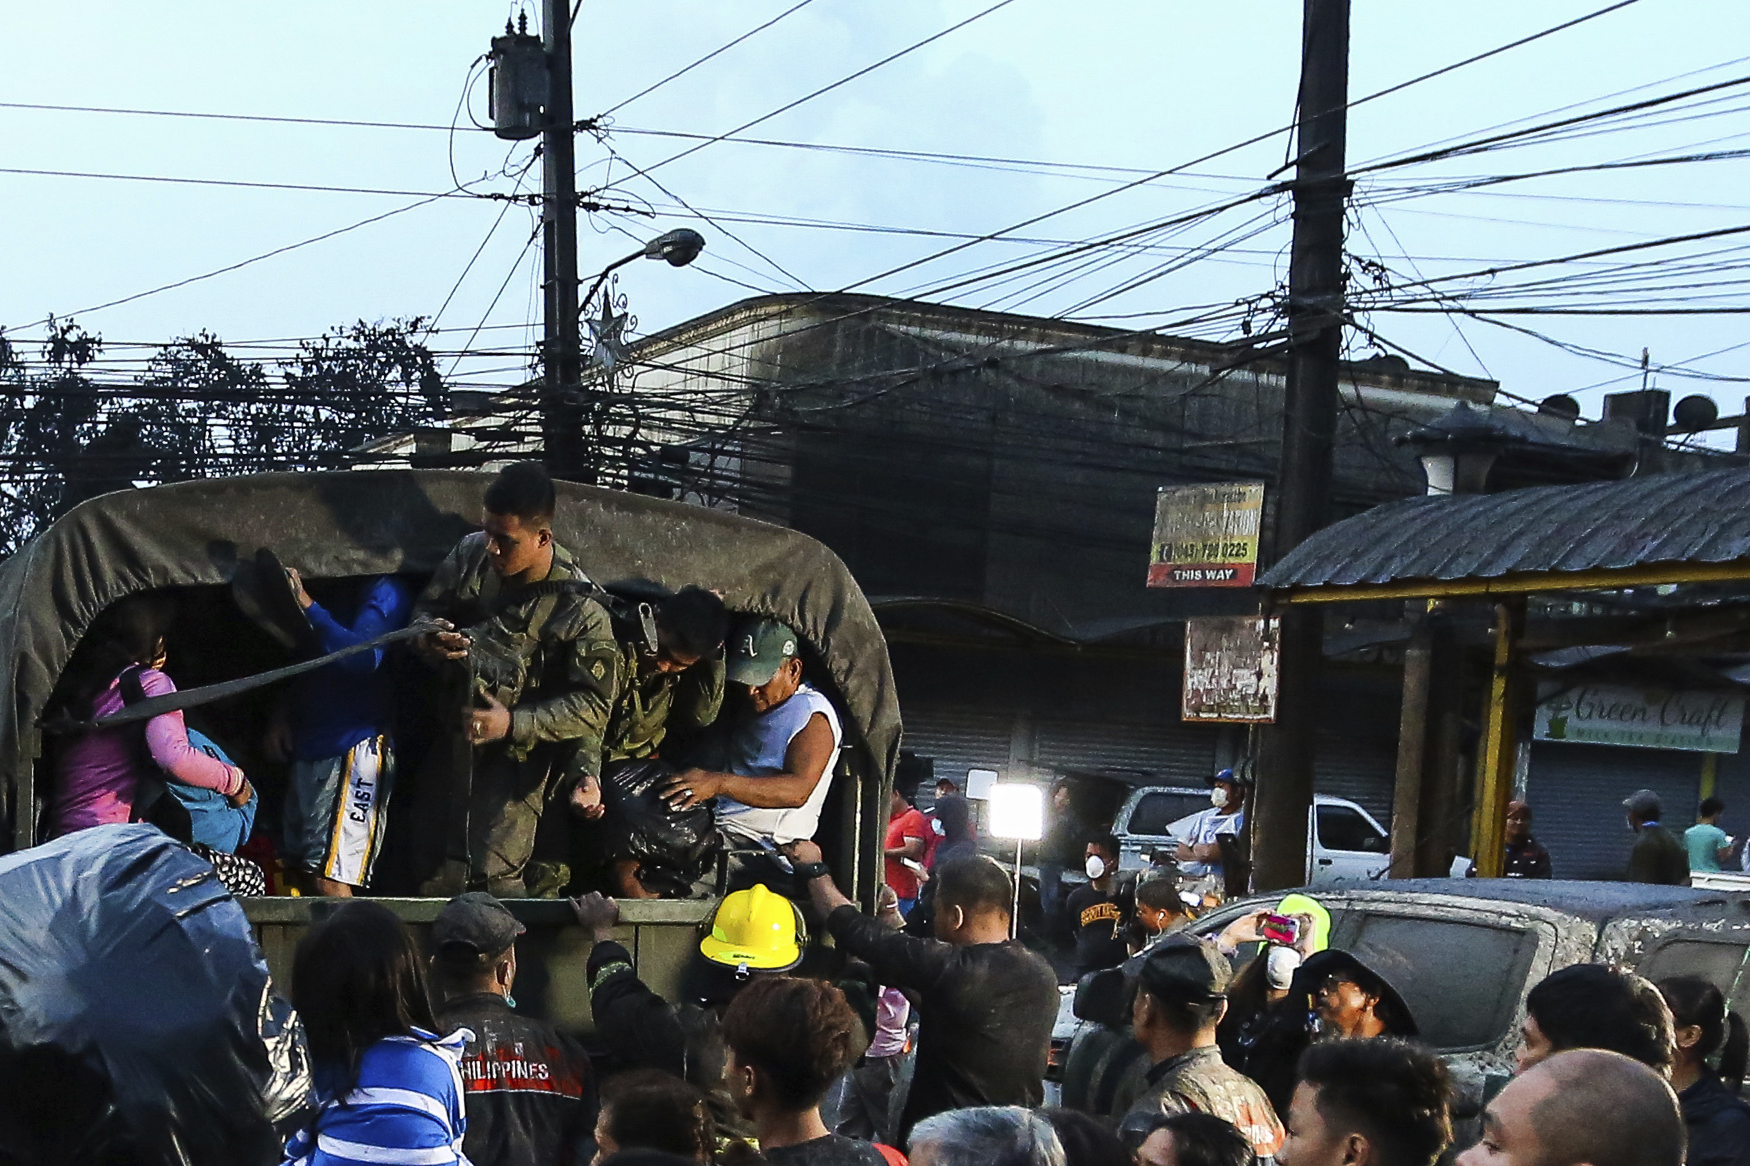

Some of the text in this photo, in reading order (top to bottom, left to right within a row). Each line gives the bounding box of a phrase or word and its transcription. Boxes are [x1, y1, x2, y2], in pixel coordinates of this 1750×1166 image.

[1222, 543, 1248, 558] 0225
[1174, 569, 1234, 581] THIS WAY
[1575, 686, 1729, 738] Green Craft
[349, 777, 376, 823] EAST
[461, 1060, 549, 1081] HILIPPINES
